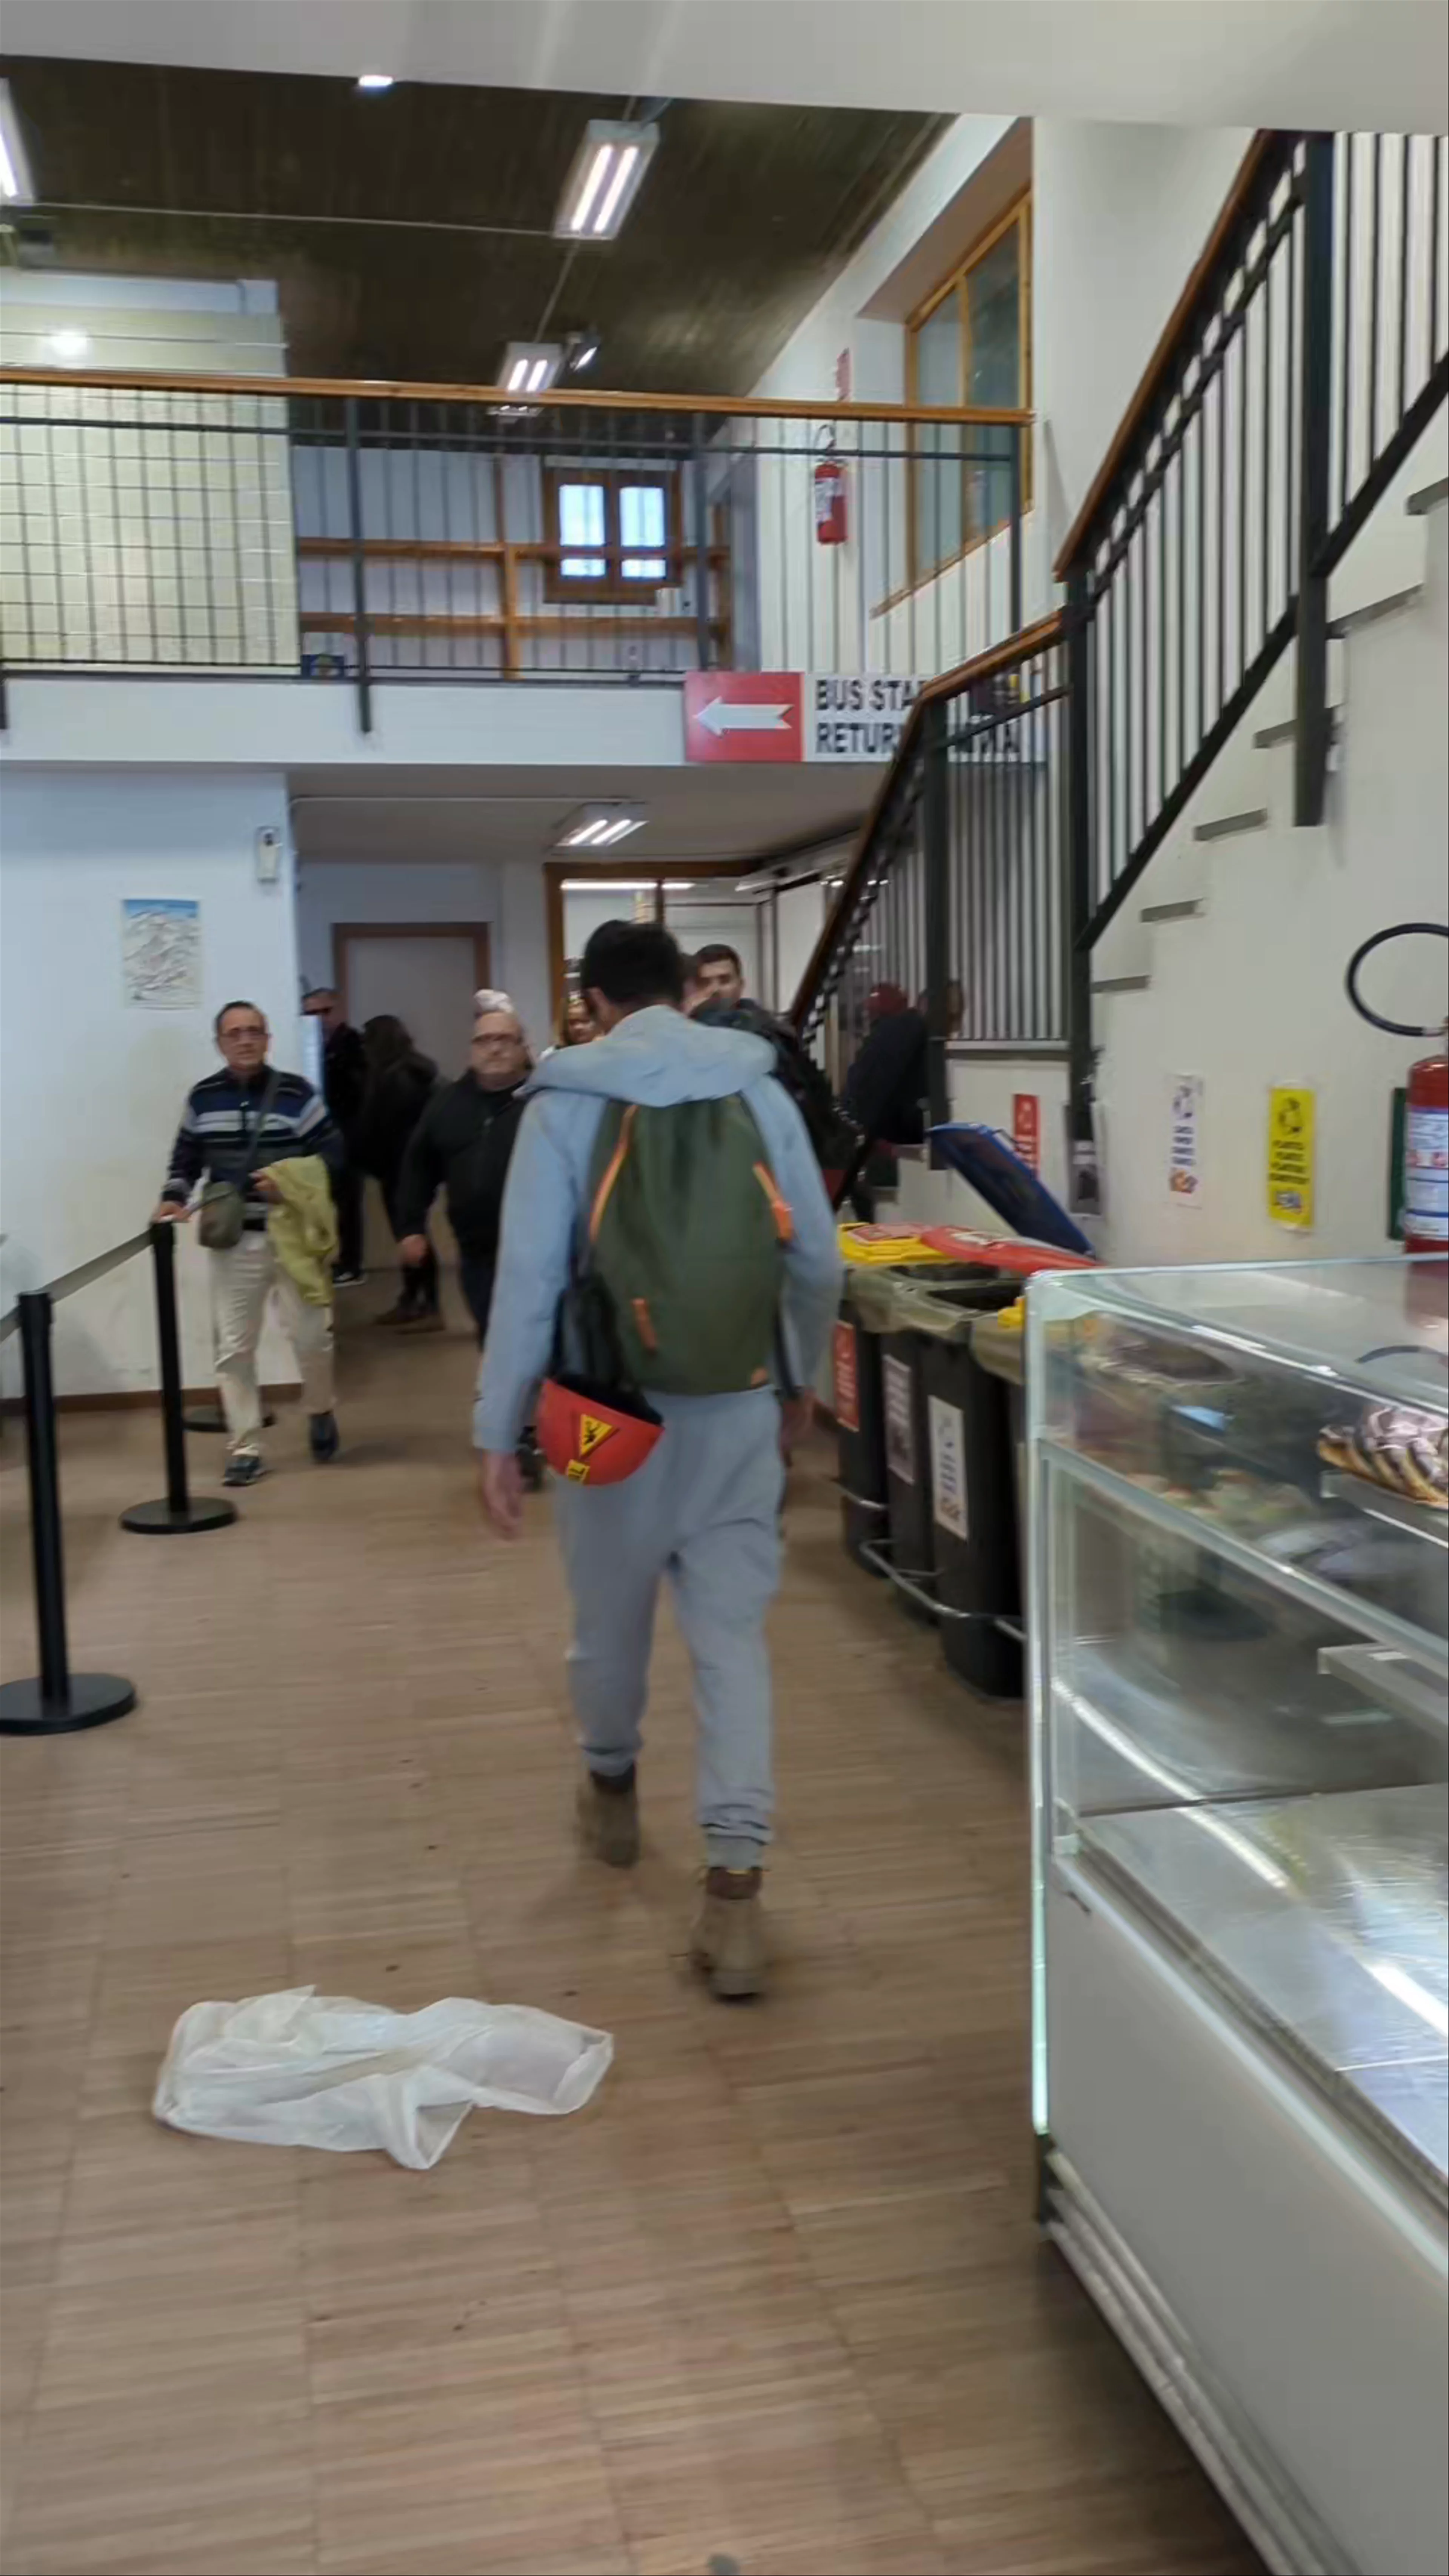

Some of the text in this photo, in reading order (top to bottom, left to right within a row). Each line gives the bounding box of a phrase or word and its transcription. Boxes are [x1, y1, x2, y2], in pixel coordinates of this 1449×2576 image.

[815, 679, 925, 711] BUS STA
[815, 722, 902, 753] RETUR
